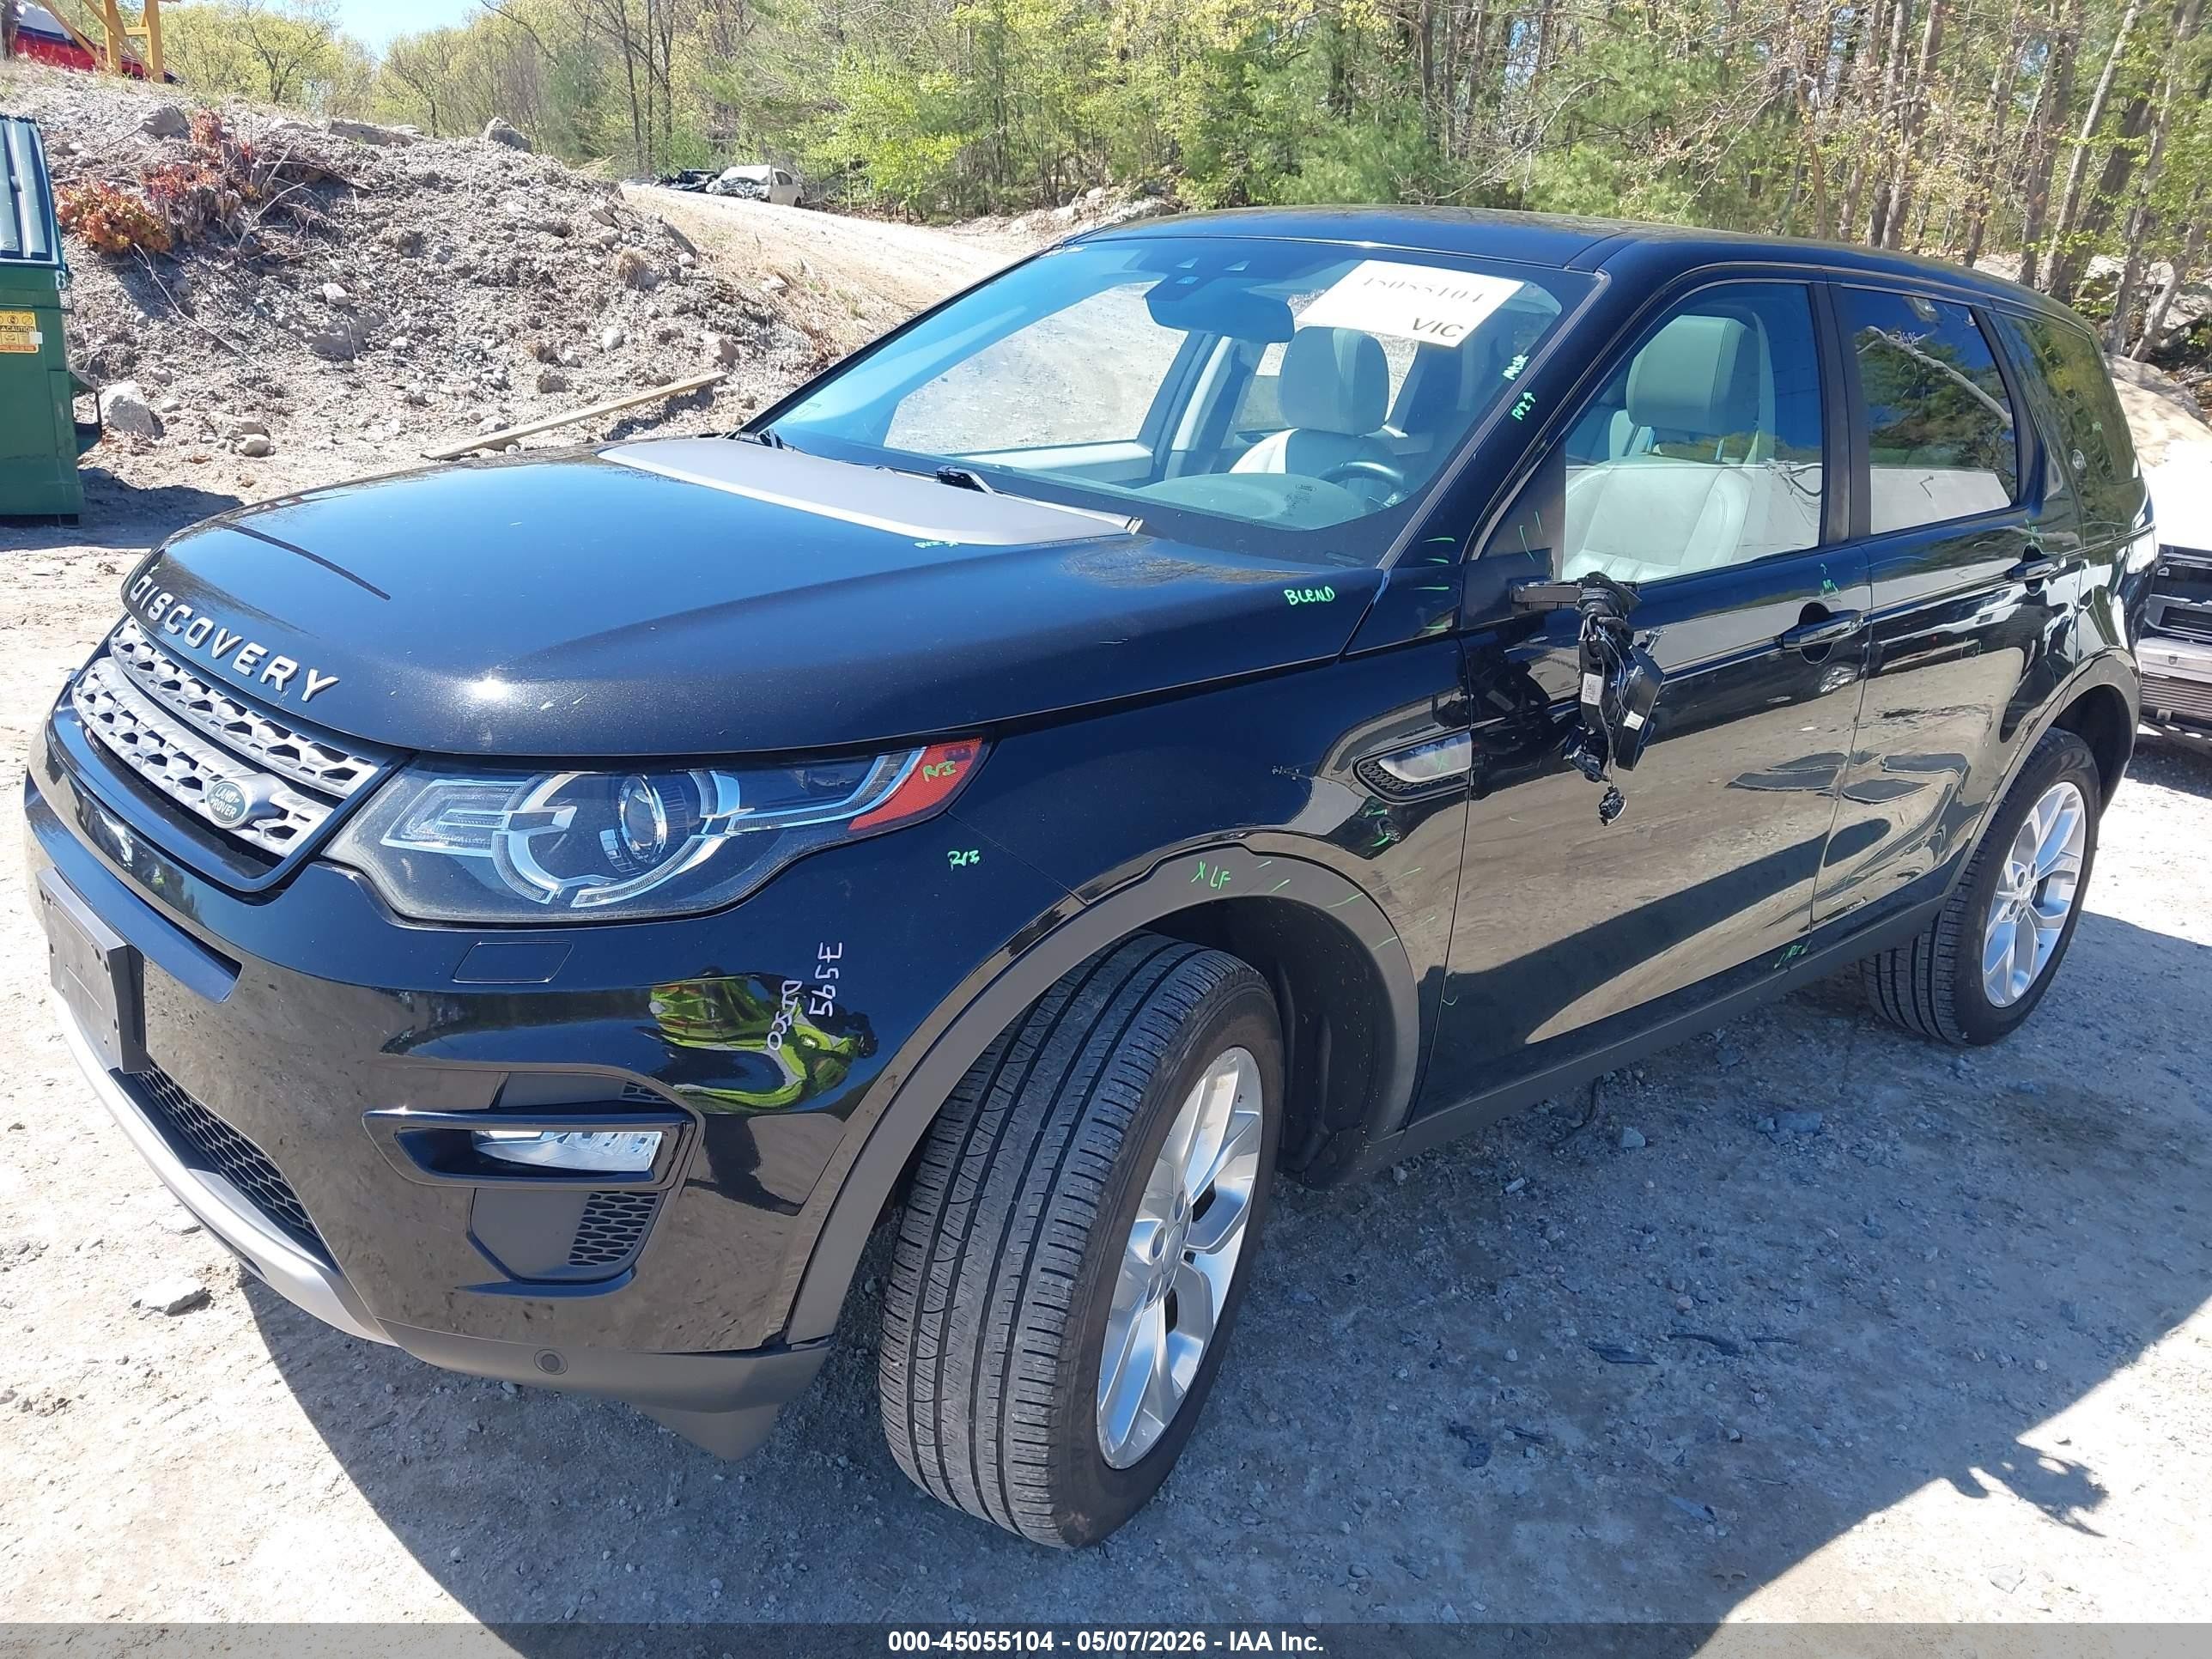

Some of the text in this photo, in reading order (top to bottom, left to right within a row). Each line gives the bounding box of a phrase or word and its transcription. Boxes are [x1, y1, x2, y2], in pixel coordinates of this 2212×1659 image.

[1413, 318, 1464, 337] VIC
[1283, 585, 1336, 606] BLEND
[130, 574, 340, 702] DISCOVERY
[215, 786, 237, 805] LAND
[212, 799, 236, 819] ROVER
